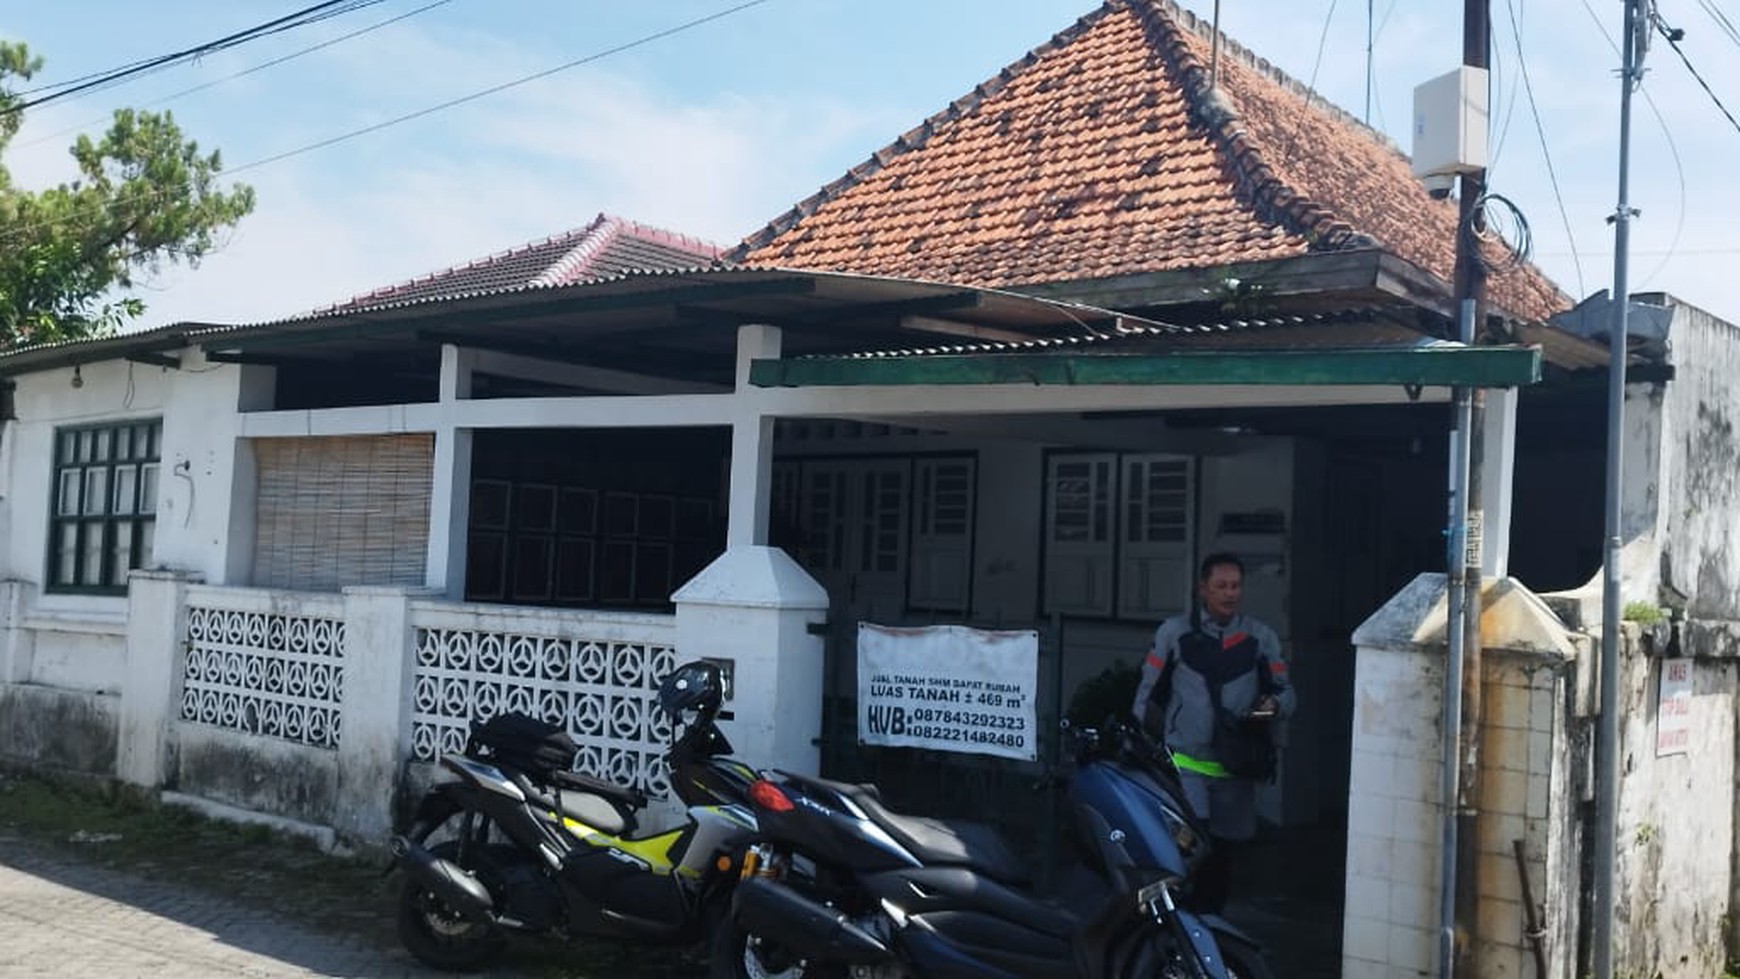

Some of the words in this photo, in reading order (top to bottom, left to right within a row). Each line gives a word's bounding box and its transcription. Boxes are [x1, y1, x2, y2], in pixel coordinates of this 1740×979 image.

[871, 674, 891, 683] JUAL
[894, 675, 925, 685] TANAH
[928, 678, 950, 687] SHM
[953, 679, 982, 690] DAPAT
[871, 685, 903, 698] LUAS
[908, 687, 959, 702] TANAH
[978, 692, 1002, 707] 469
